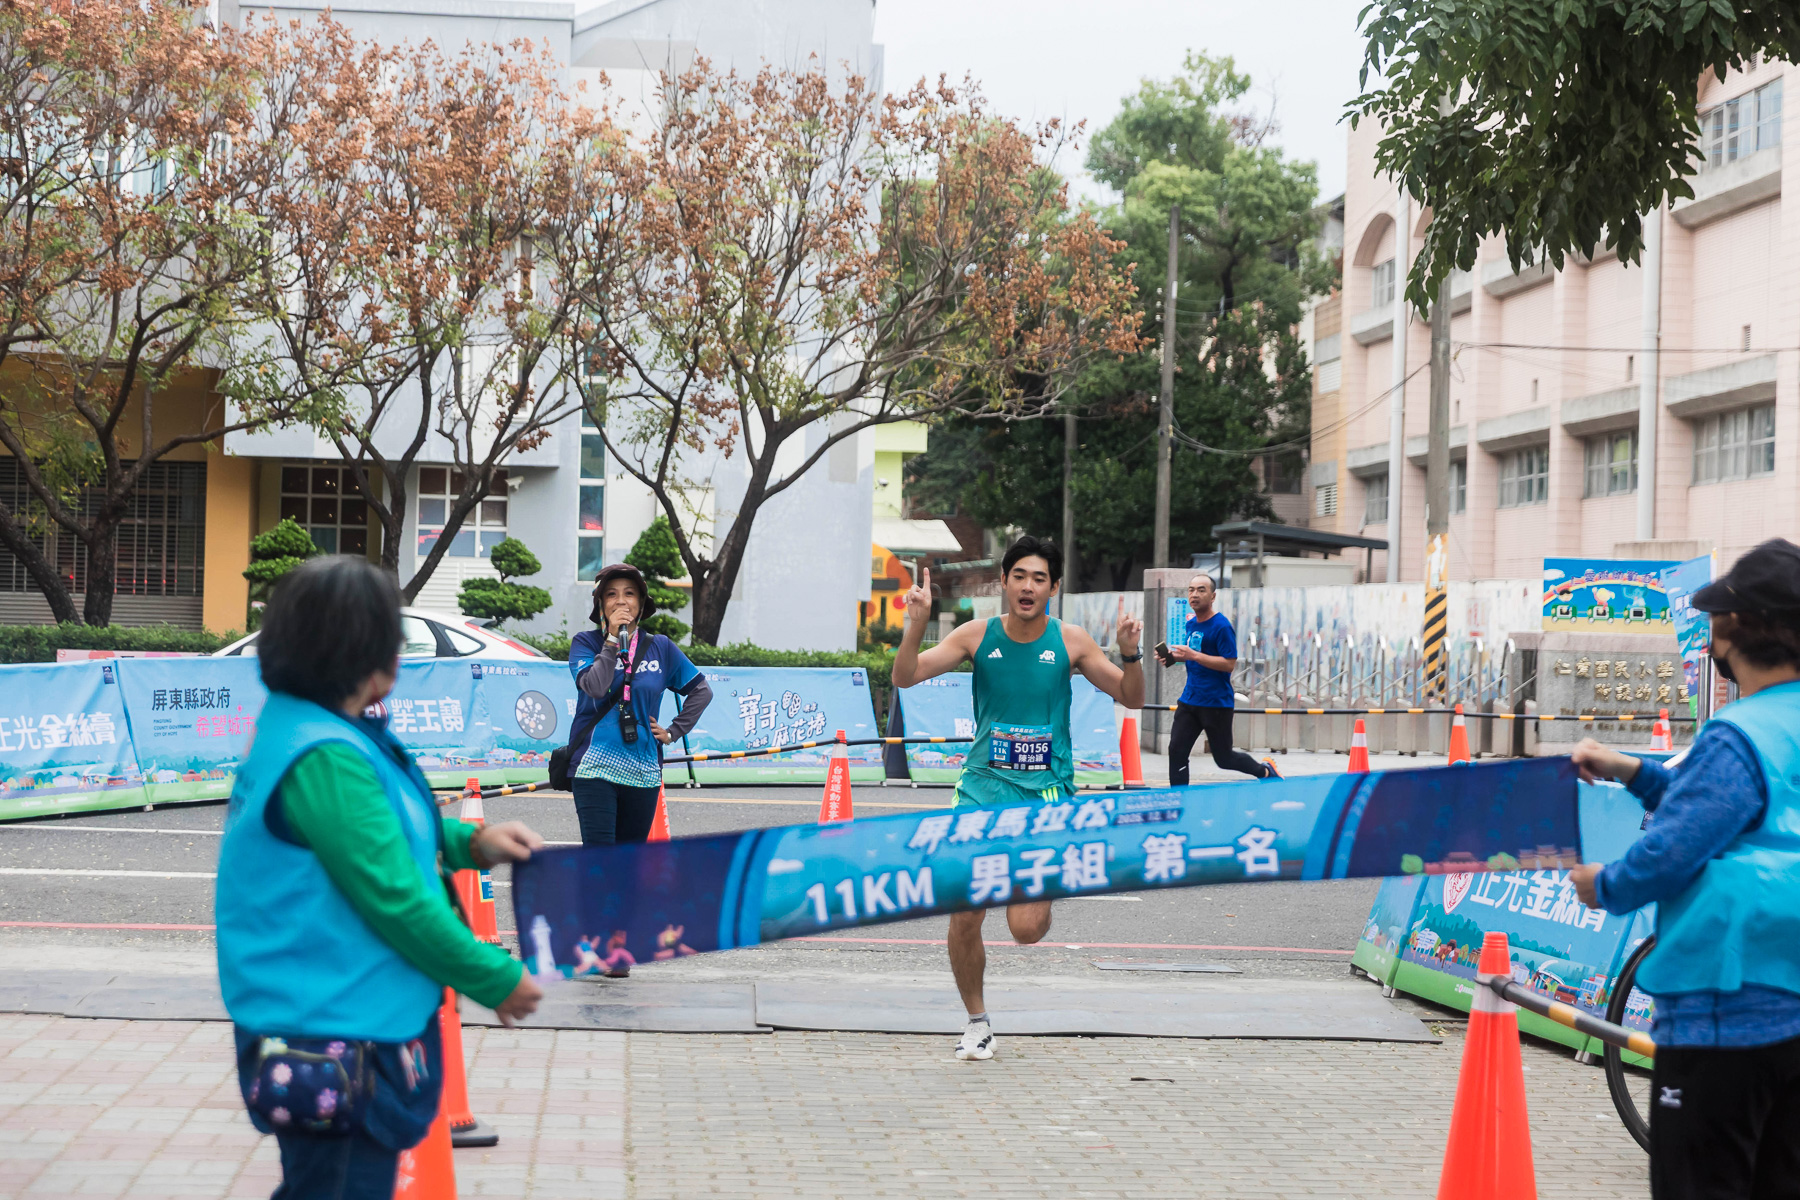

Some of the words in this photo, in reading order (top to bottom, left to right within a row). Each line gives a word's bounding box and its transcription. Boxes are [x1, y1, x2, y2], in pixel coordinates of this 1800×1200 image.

[1553, 656, 1675, 680] 仁愛國民小學
[151, 686, 231, 711] 屏東縣政府
[196, 714, 256, 738] 希望城市
[771, 711, 826, 747] 麻花捲
[993, 747, 1007, 755] 11K
[1014, 742, 1049, 754] 50156
[907, 797, 1115, 853] 屏東馬拉松
[805, 866, 936, 924] 11KM
[969, 842, 1109, 904] 男子組
[1142, 826, 1280, 881] 第一名
